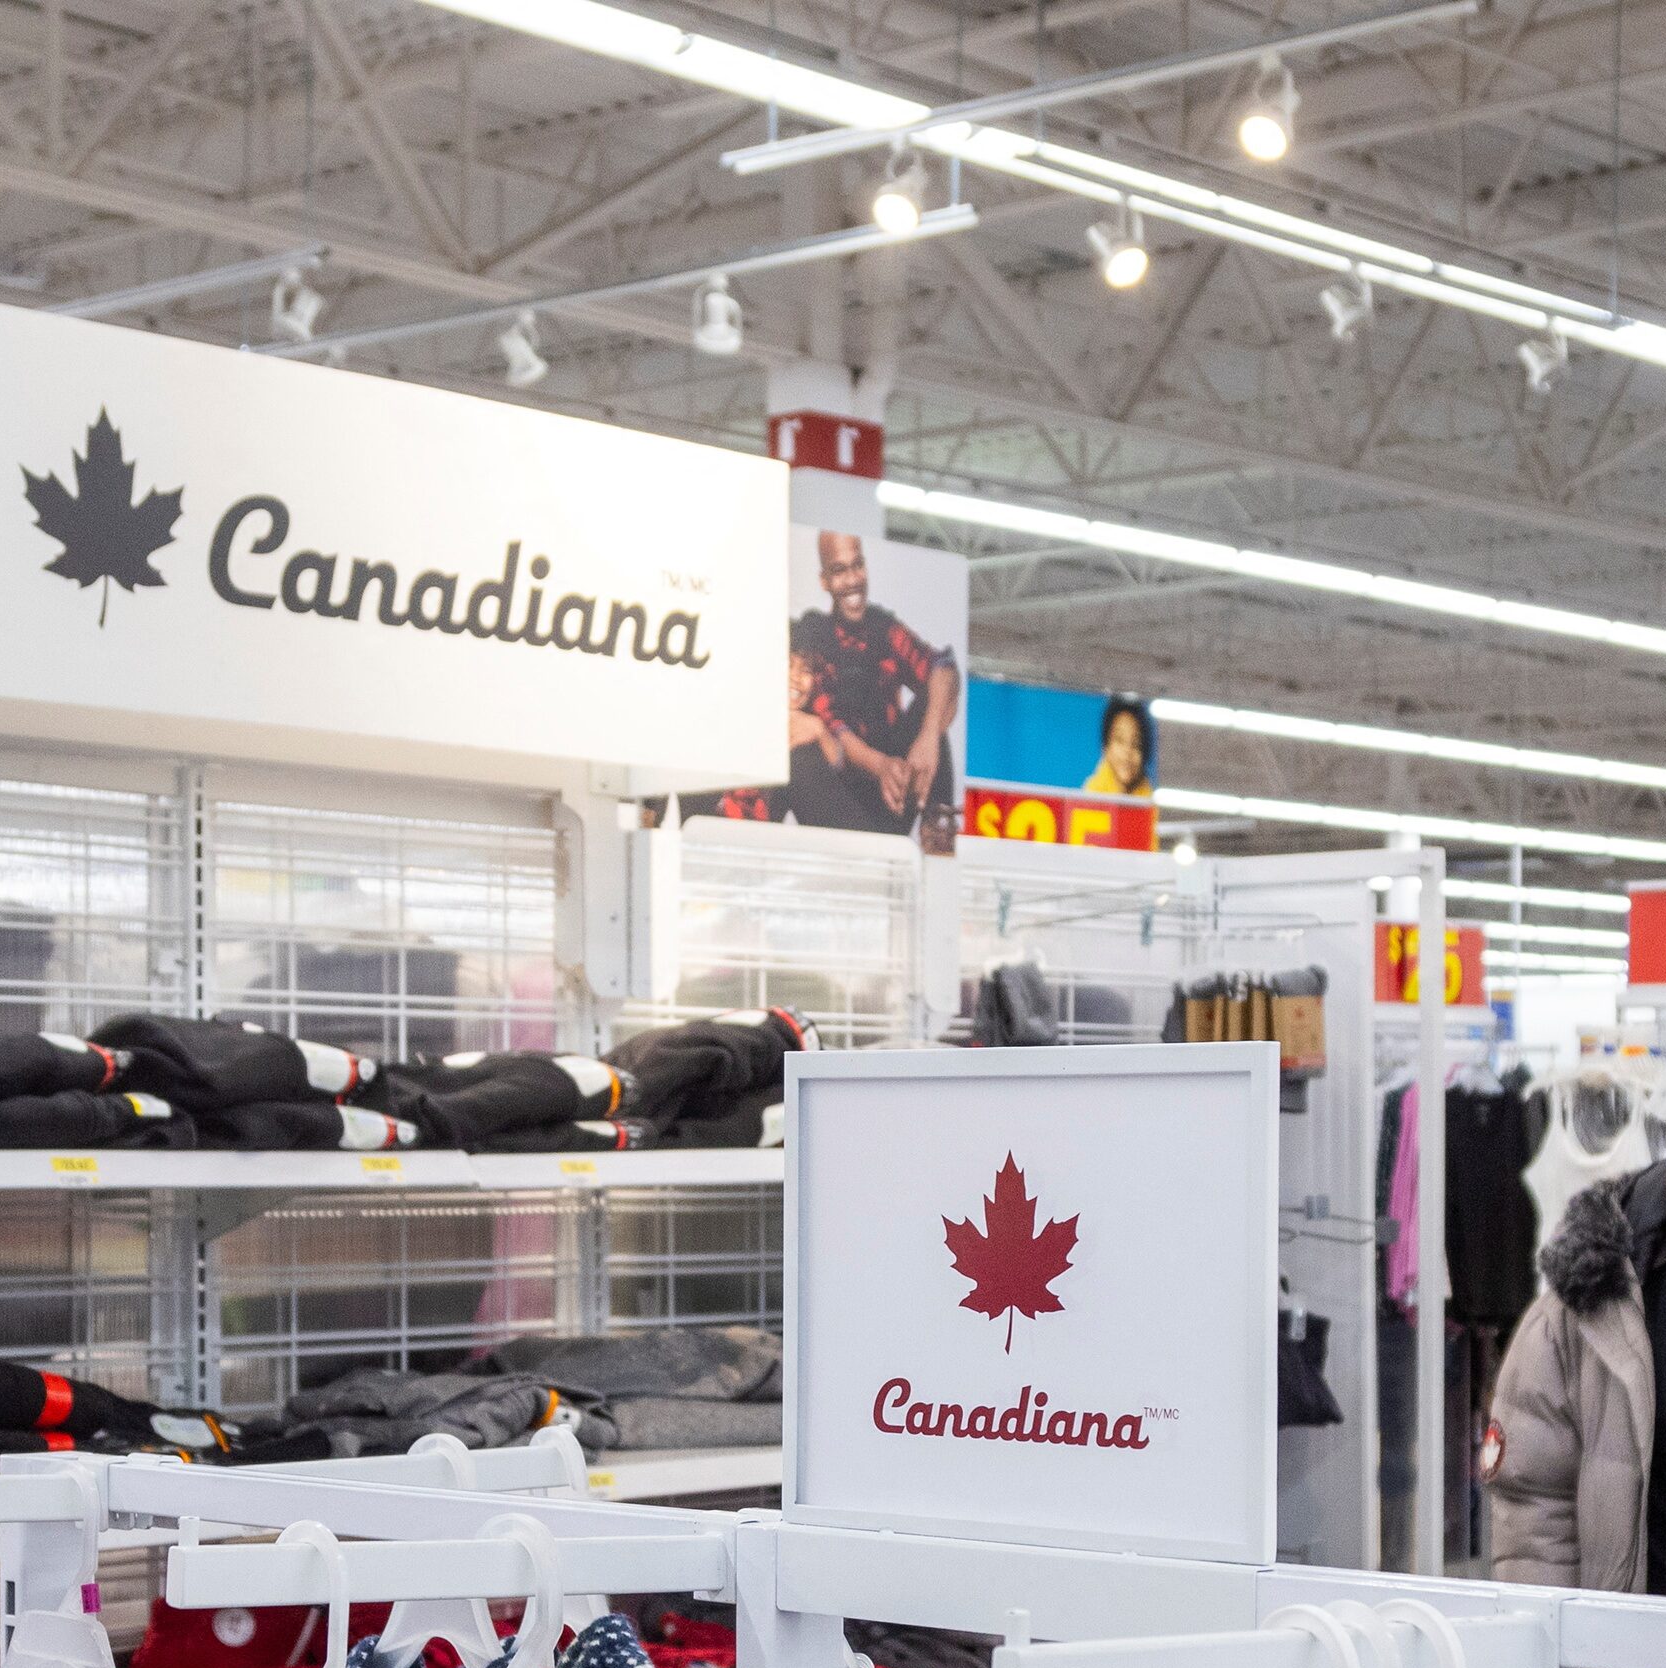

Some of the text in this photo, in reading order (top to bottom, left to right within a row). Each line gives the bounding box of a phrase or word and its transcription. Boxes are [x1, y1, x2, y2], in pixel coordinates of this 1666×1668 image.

[207, 494, 711, 669] Canadiana
[873, 1377, 1180, 1450] Canadiana TM/MC
